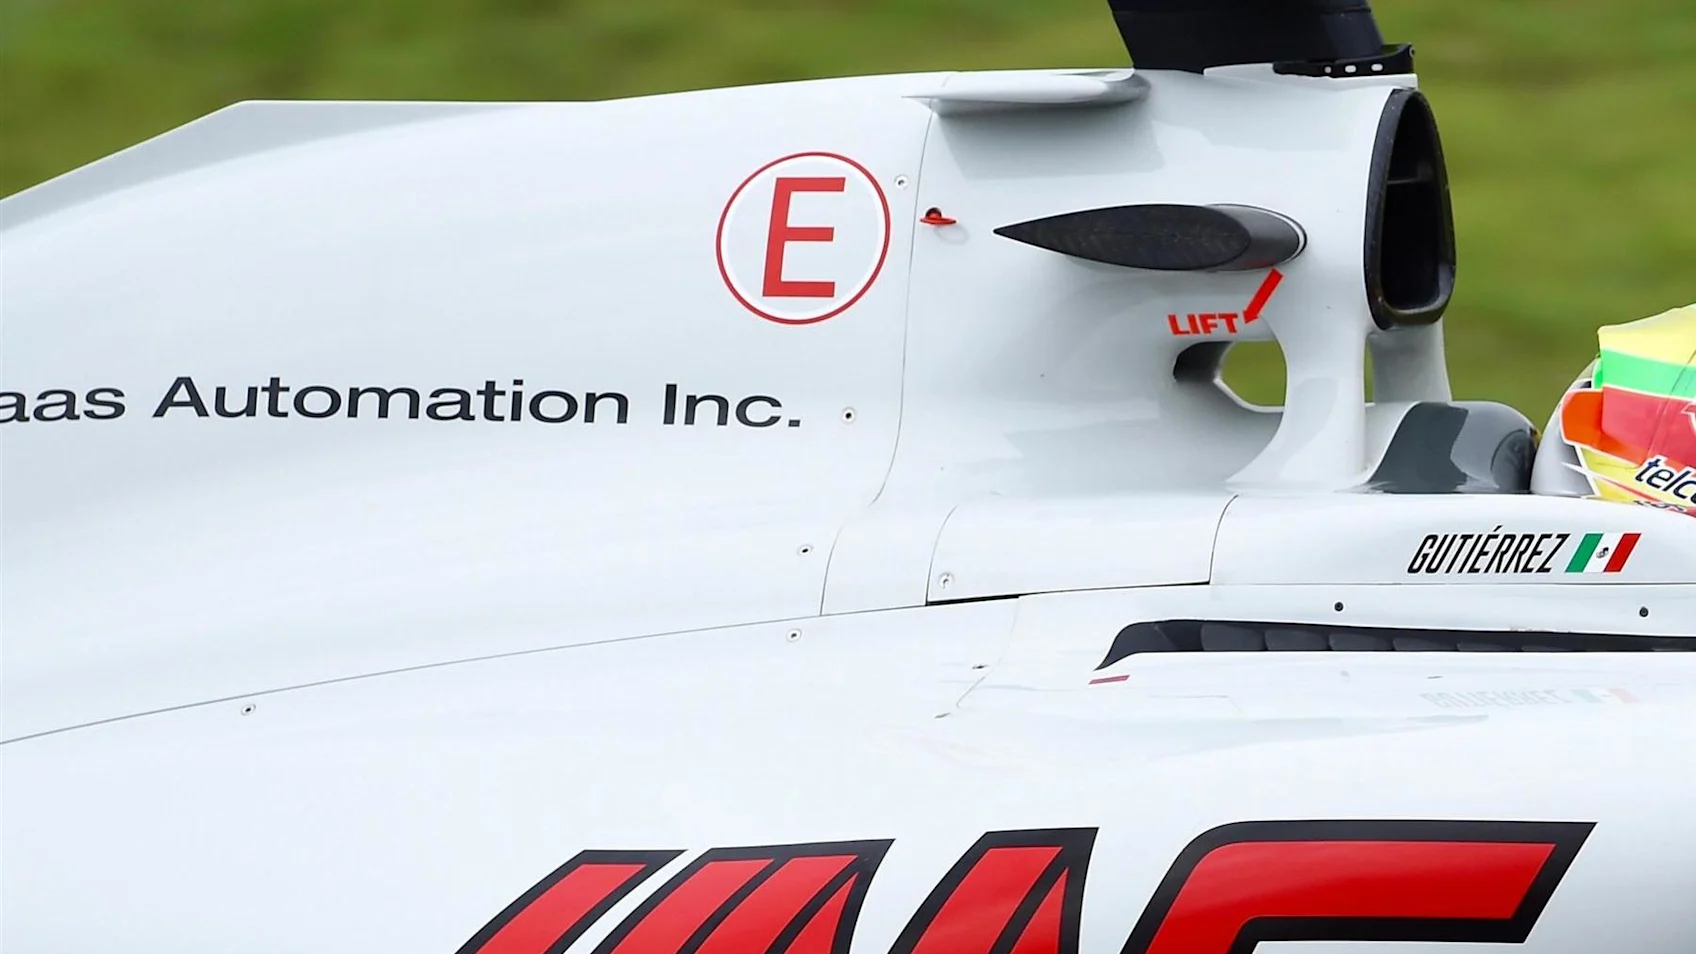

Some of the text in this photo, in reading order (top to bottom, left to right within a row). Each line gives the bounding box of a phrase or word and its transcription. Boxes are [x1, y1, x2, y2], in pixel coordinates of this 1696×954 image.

[762, 176, 846, 298] E
[1167, 312, 1238, 336] LIFT
[152, 376, 629, 424] Automation
[662, 383, 801, 428] Inc.
[1406, 525, 1572, 574] GUTIÉRREZ
